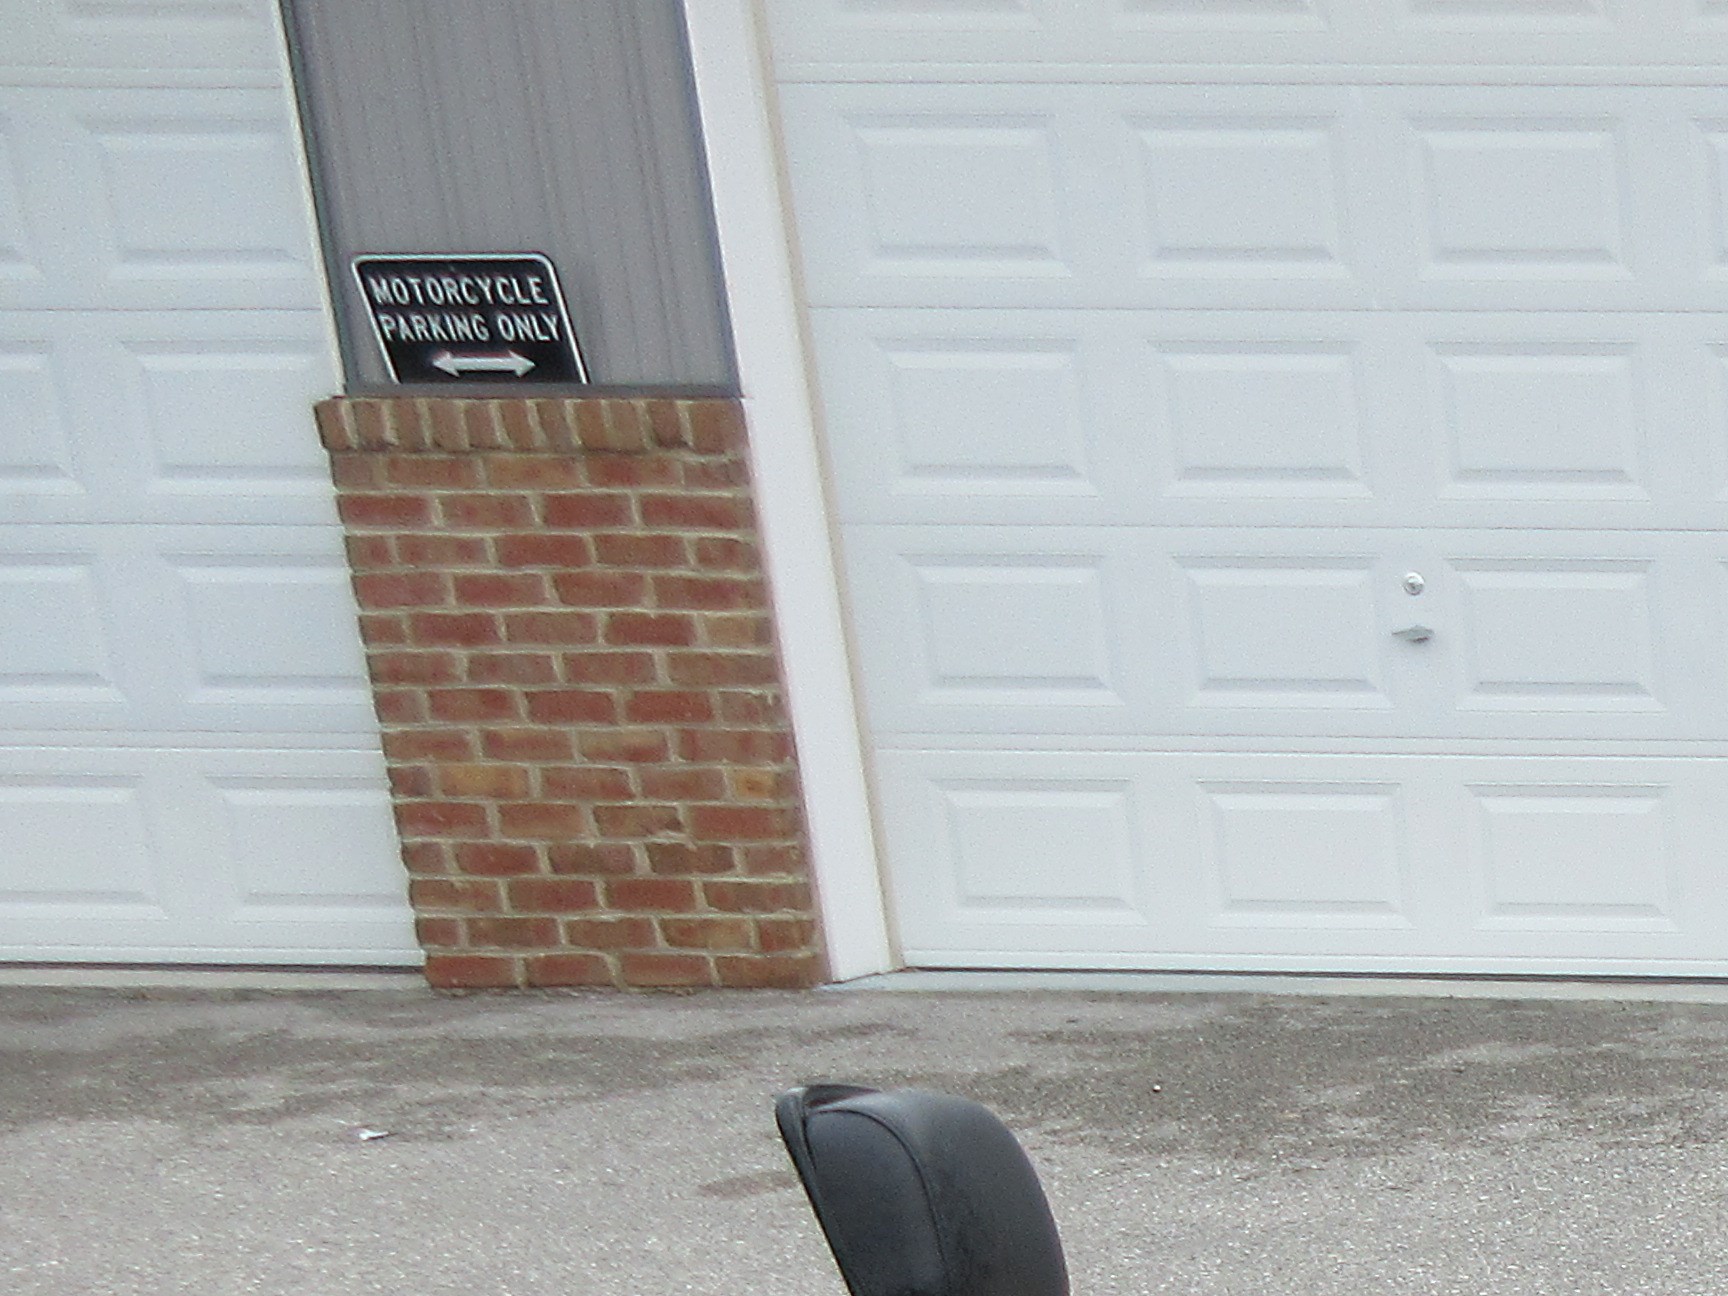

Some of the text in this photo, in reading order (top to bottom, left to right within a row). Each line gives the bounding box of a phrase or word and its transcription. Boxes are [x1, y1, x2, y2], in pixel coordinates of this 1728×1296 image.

[368, 276, 549, 306] MOTORCYCLE
[377, 313, 562, 342] PARKING ONLY
